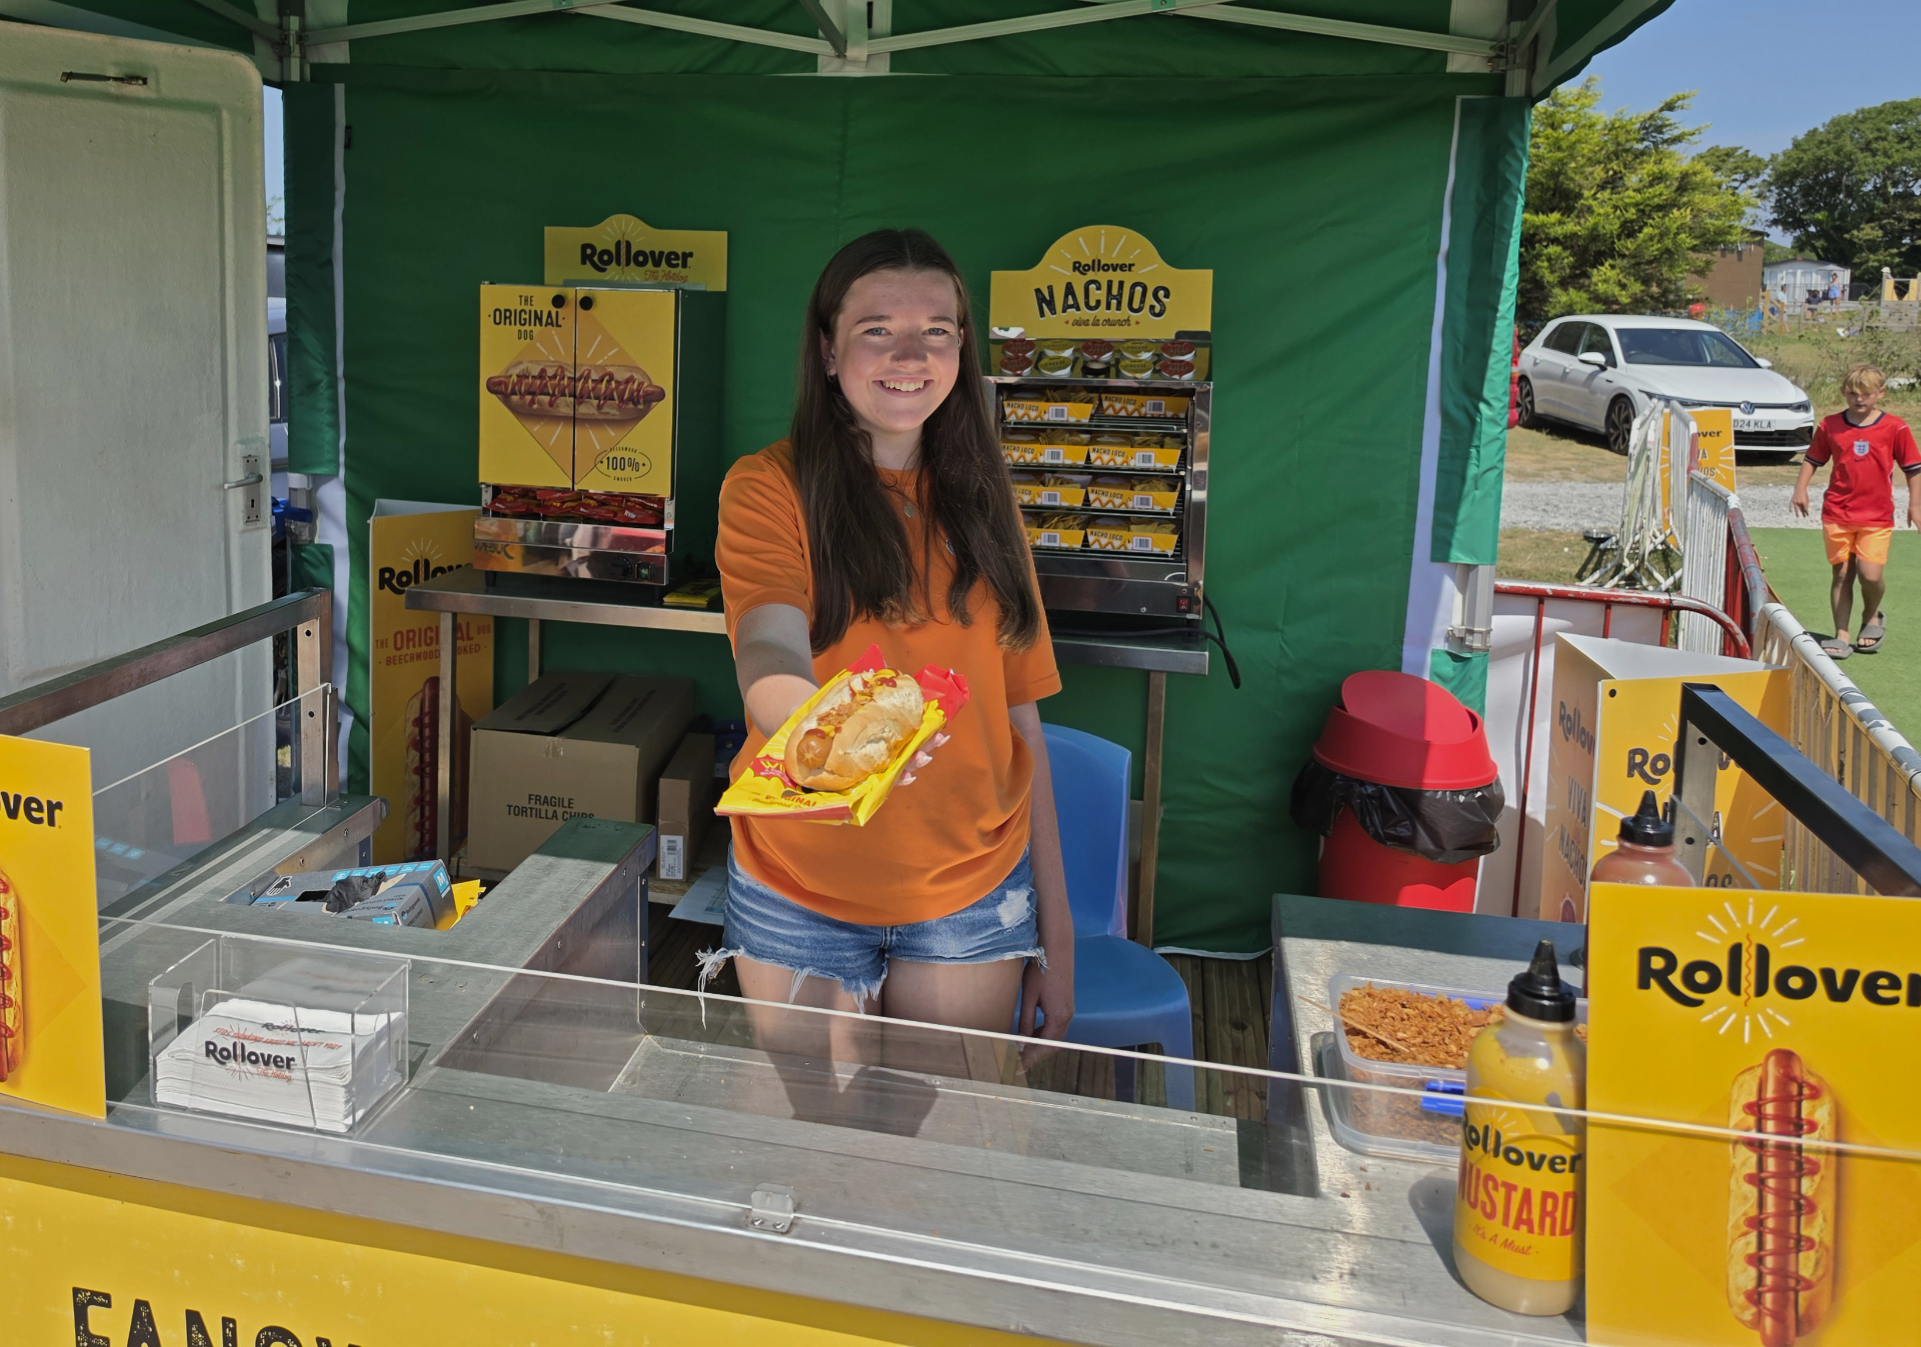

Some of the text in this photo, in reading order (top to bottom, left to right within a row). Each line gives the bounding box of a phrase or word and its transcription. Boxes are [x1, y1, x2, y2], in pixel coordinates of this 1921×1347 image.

[580, 239, 694, 273] Rollover
[1072, 258, 1136, 276] Rollover
[519, 295, 534, 306] THE
[1034, 279, 1171, 319] NACHOS
[493, 307, 563, 328] ORIGINAL
[517, 329, 534, 341] DOG
[1006, 402, 1039, 412] NACHO LOCO
[1104, 395, 1137, 406] NACHO LOCO
[1754, 420, 1772, 429] KLA
[1001, 444, 1035, 455] NACHO LOCO
[1091, 447, 1126, 458] NACHO LOCO
[606, 456, 640, 472] 100%
[1089, 488, 1124, 500] NACHO LOCO
[1089, 530, 1123, 542] NACHO LOCO
[375, 638, 389, 650] THE
[393, 621, 474, 652] ORIGIAL
[456, 643, 481, 656] OKED
[528, 793, 574, 809] FRAGILE
[1568, 775, 1588, 829] VIVA
[507, 804, 558, 821] TORTILLA
[205, 1040, 296, 1070] Rollover
[1473, 1224, 1533, 1256] It's A Must
